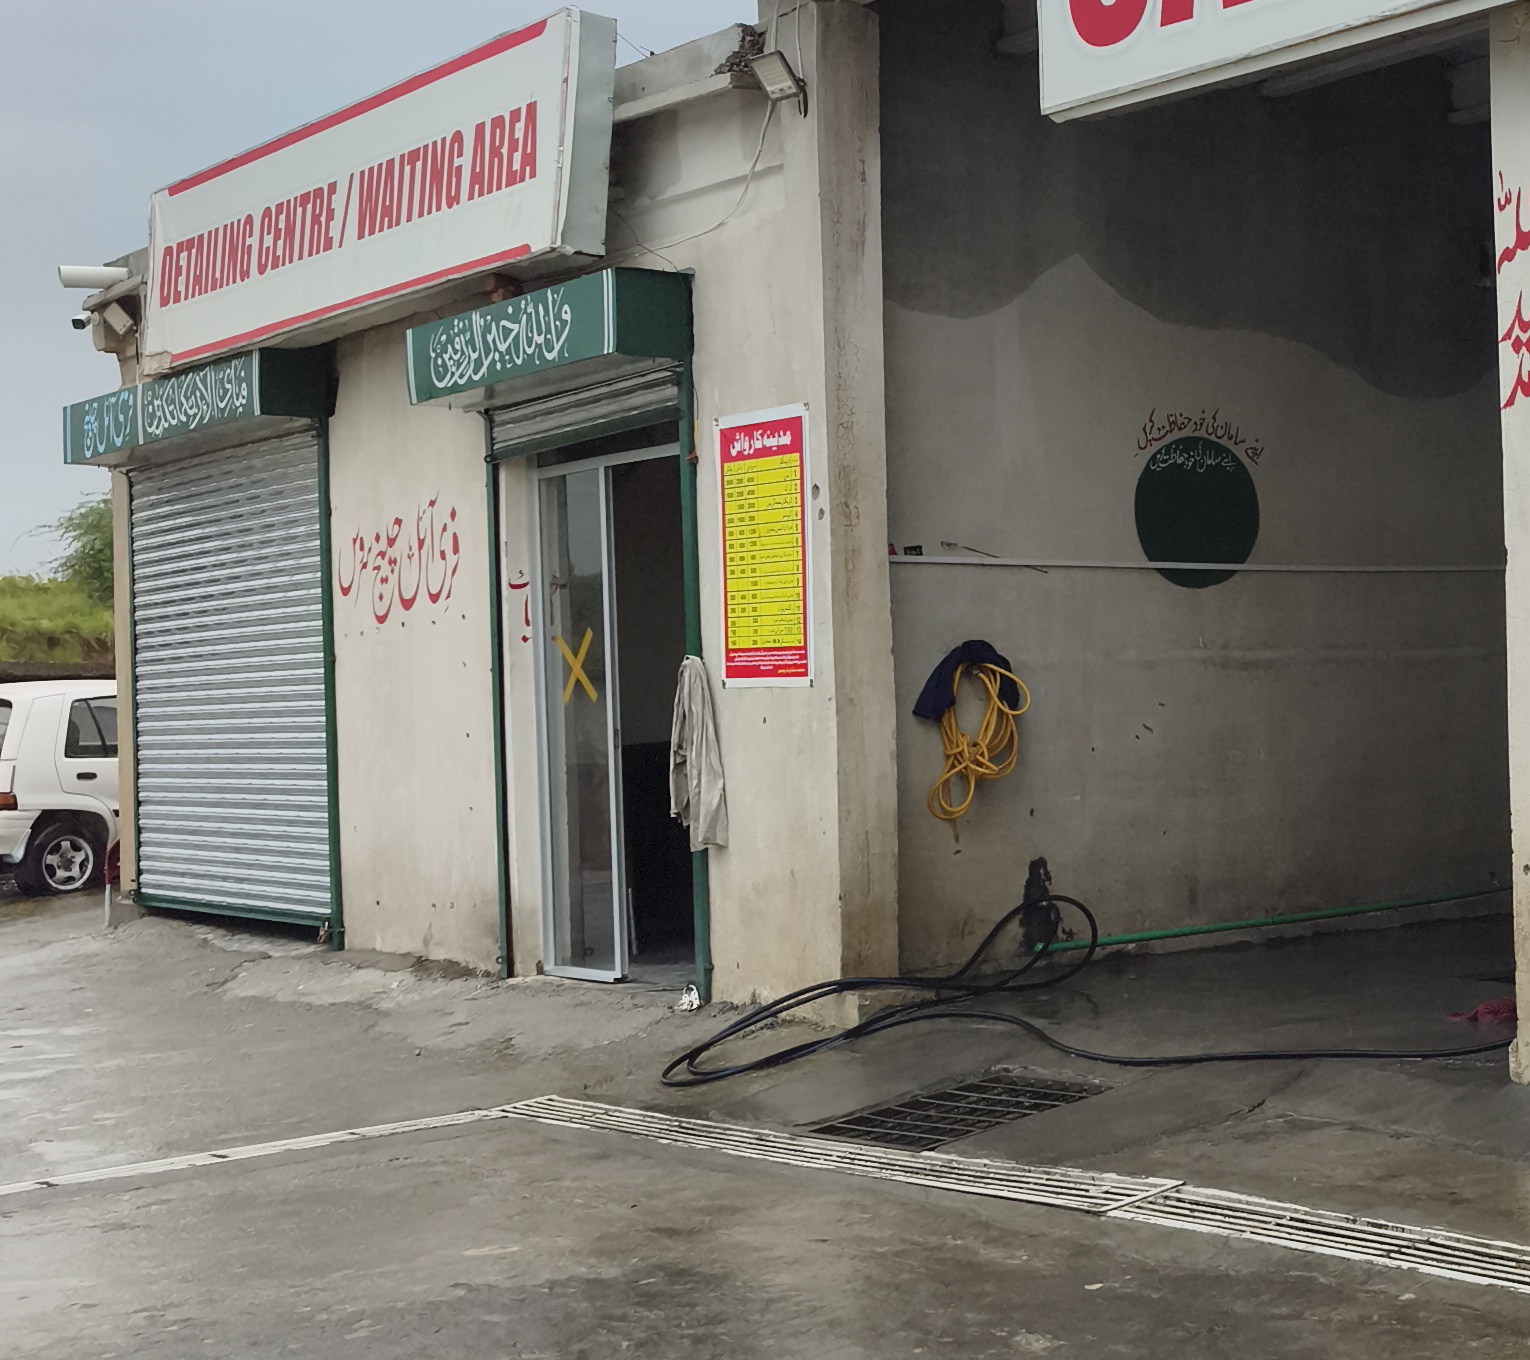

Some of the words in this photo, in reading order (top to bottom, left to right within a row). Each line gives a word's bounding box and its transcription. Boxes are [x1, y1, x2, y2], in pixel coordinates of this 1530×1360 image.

[158, 212, 254, 309] DETAILING
[256, 180, 339, 277] CENTRE
[337, 172, 355, 249] /
[356, 129, 465, 241] WAITING
[467, 99, 538, 202] AREA
[112, 390, 134, 448] فری
[1152, 412, 1193, 442] حفاظت
[1192, 409, 1206, 433] خود
[1206, 408, 1220, 436] کی
[1215, 421, 1247, 446] سامان
[762, 429, 792, 451] مدینہ
[1196, 450, 1221, 473] سامان
[372, 517, 404, 625] چینج
[426, 507, 460, 614] فری
